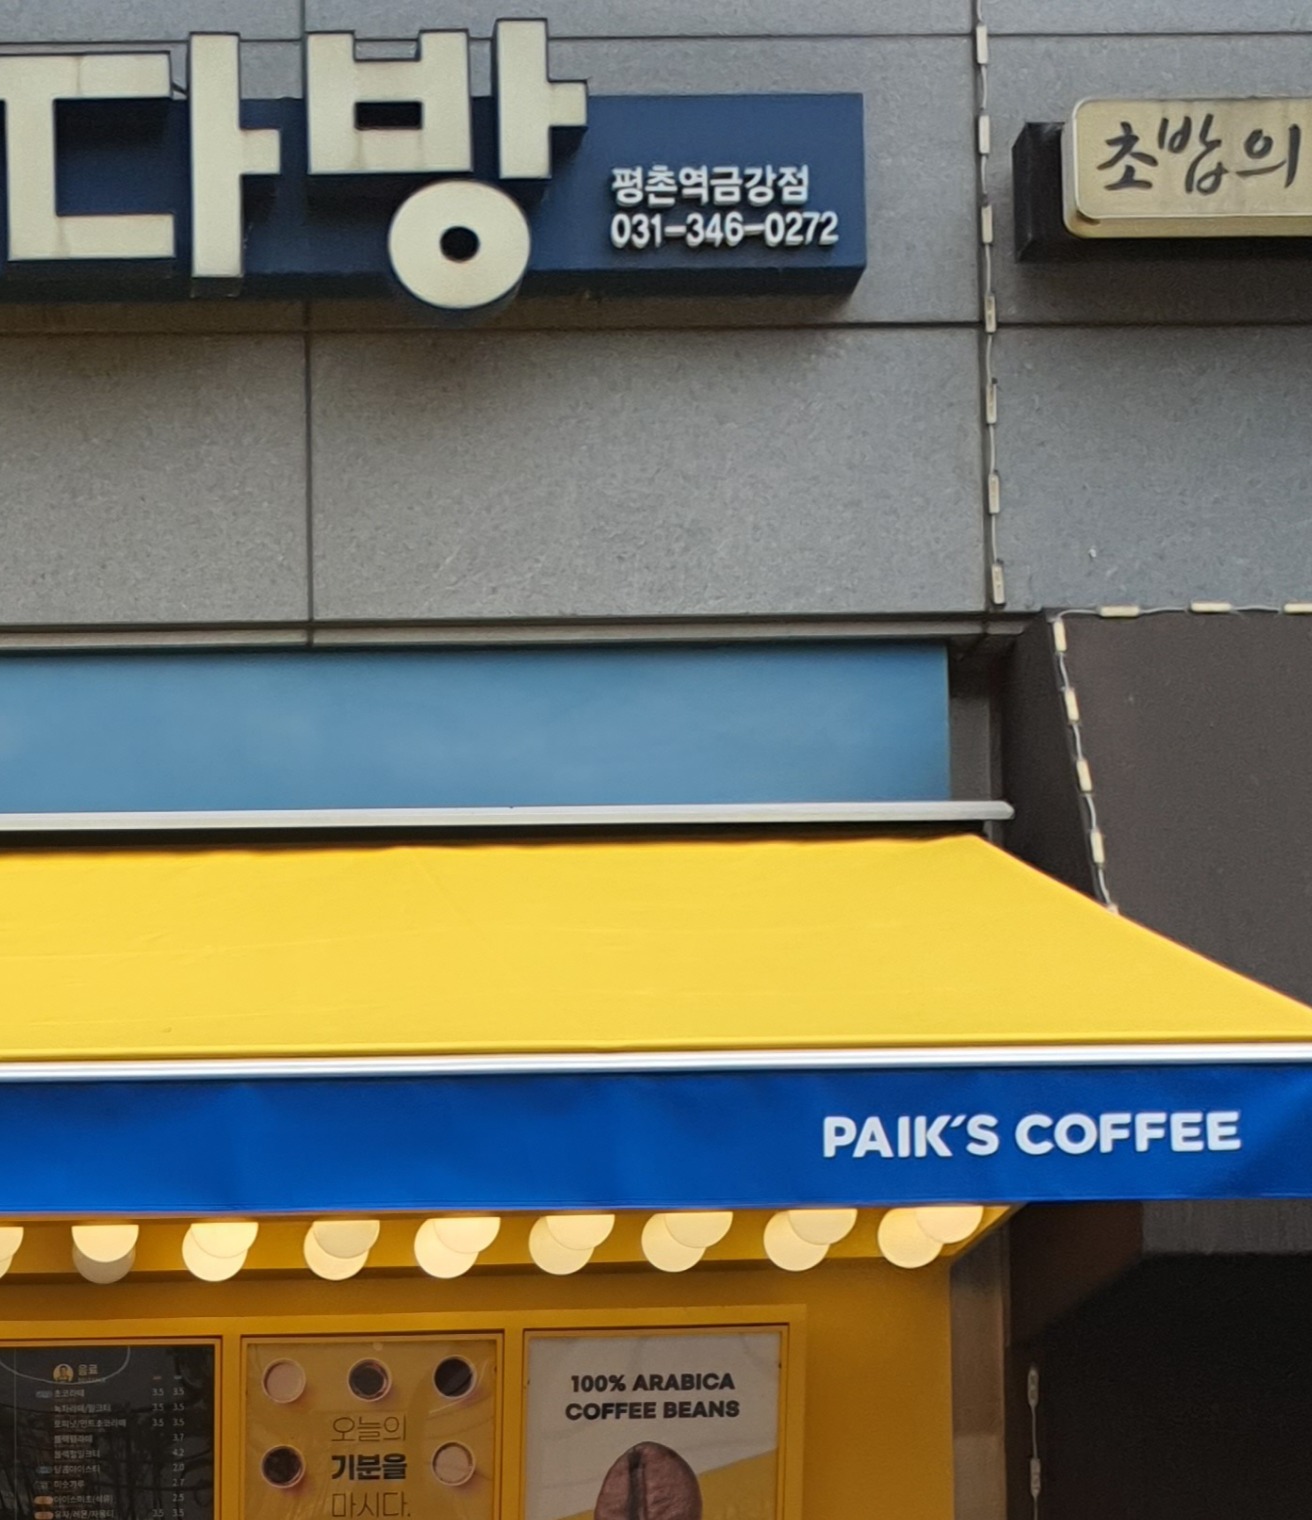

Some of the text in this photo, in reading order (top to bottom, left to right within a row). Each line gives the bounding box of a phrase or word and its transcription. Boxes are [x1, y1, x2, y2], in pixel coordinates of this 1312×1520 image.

[611, 165, 810, 208] 평촌역금강점
[610, 211, 840, 249] 031-346-0272
[823, 1110, 1241, 1158] PAIK'S COFFEE
[571, 1373, 735, 1392] 100% ARABICA
[565, 1400, 740, 1420] COFFEE BEANS
[331, 1415, 407, 1442] 오늘의
[331, 1453, 407, 1481] 기분을
[331, 1491, 411, 1518] 마시다.
